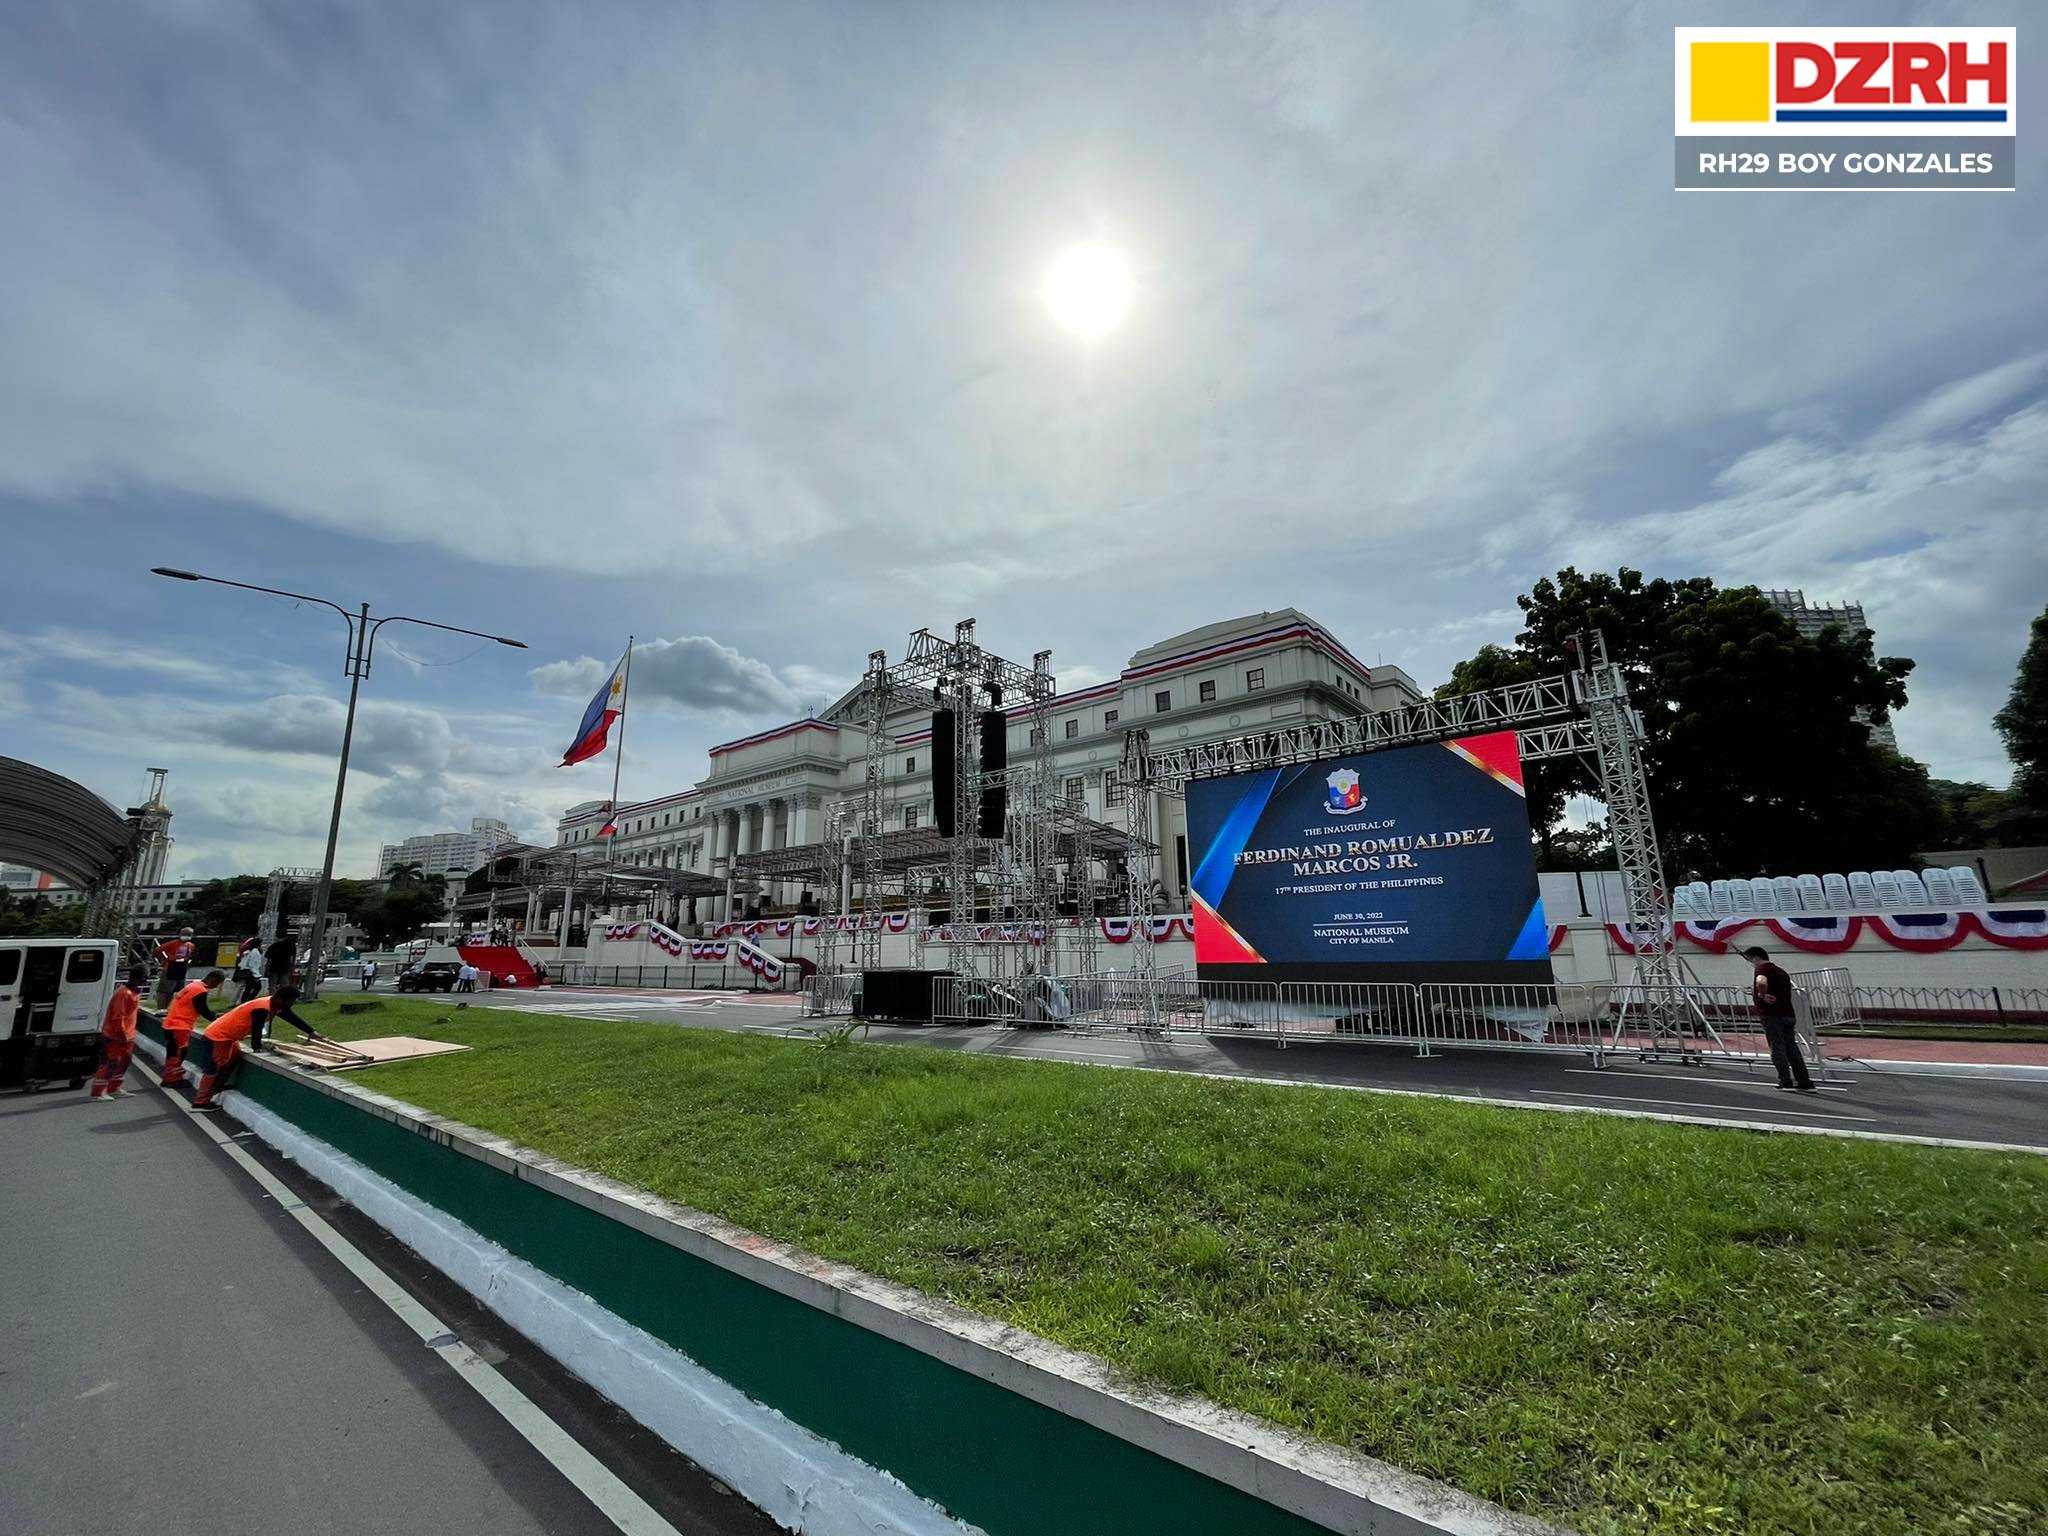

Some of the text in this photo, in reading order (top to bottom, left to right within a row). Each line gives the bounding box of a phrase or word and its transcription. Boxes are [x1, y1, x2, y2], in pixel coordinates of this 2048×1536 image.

[1304, 820, 1396, 836] THE INAUGURAL OF
[1234, 828, 1494, 865] FERDINAND ROMUALDEZ
[1293, 853, 1418, 876] MARCOS JR.
[1293, 884, 1343, 894] PRESIDENT
[1345, 882, 1358, 890] OF
[1359, 881, 1379, 889] THE
[1381, 877, 1444, 888] PHILIPPINES
[1334, 913, 1353, 921] JUNE
[1313, 926, 1409, 937] NATIONAL MUSEUM
